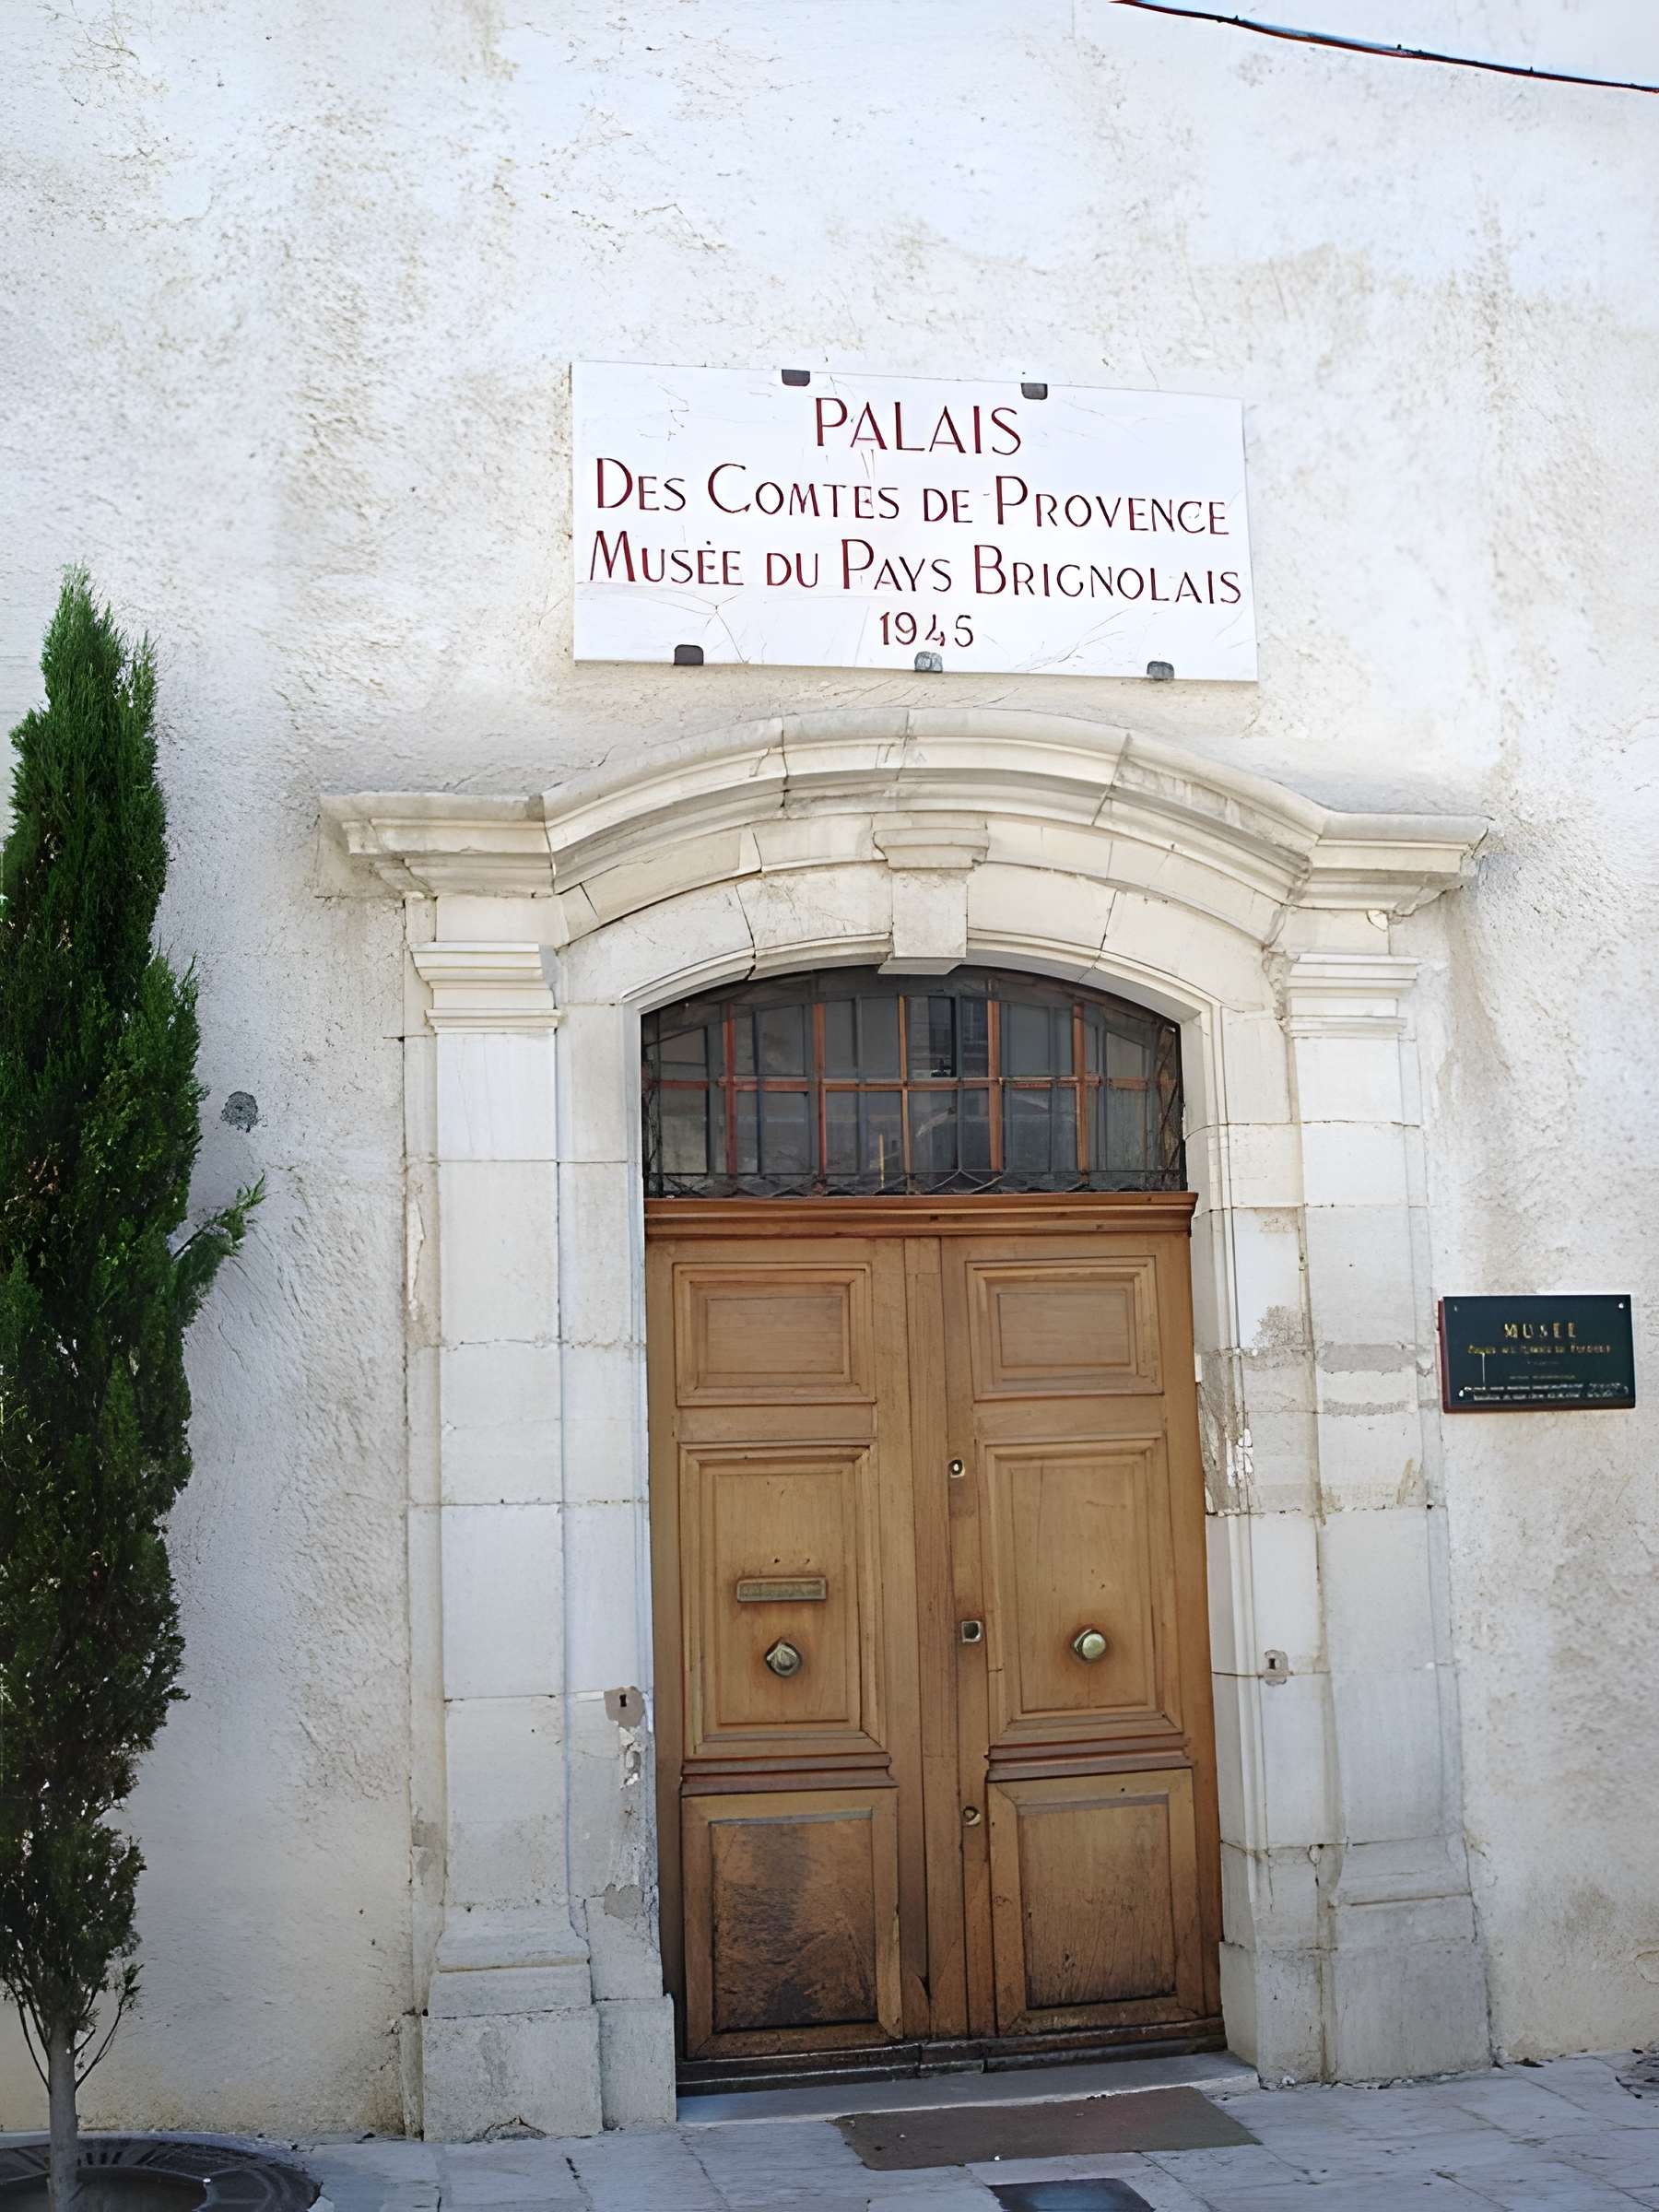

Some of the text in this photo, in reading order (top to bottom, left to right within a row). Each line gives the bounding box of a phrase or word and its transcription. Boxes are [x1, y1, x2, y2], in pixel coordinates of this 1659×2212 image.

[815, 397, 1022, 455] PALAIS
[596, 457, 1230, 535] DES COMTES DE PROVENCE
[766, 551, 819, 588] DU
[841, 538, 952, 593] PAYS
[973, 545, 1242, 604] BRIGNOLAIS
[879, 611, 975, 647] 1945
